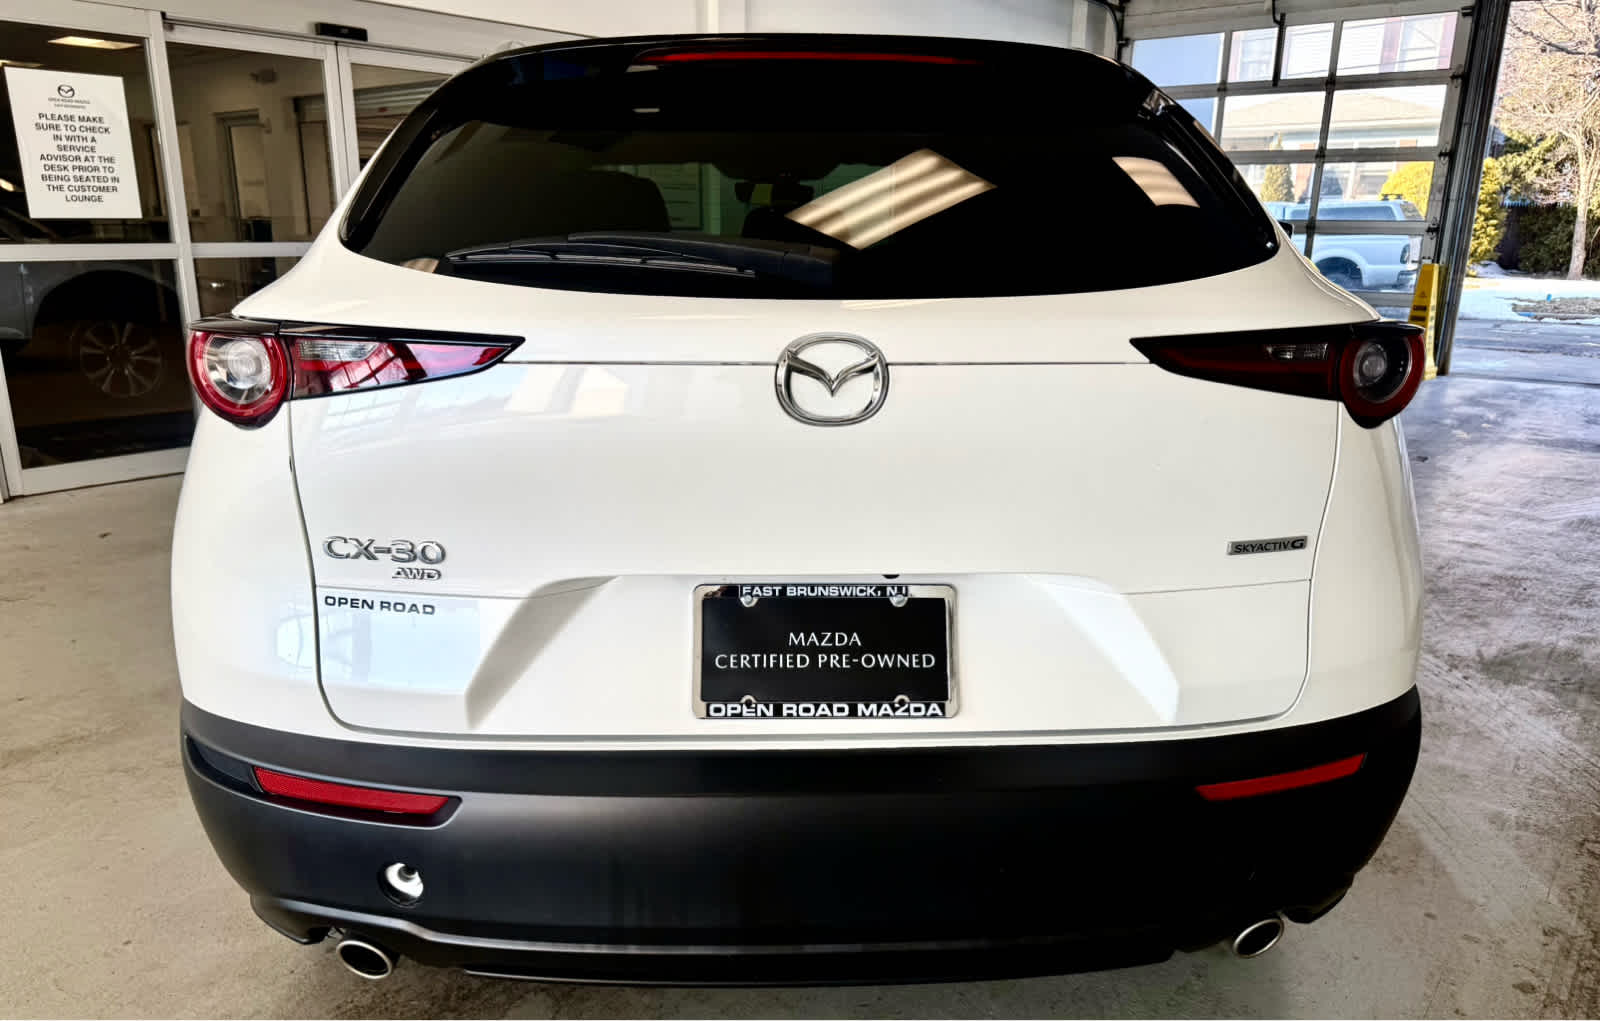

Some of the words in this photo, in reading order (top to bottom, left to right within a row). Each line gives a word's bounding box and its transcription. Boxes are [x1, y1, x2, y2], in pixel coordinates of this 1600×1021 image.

[38, 112, 75, 122] PLEASE
[78, 115, 104, 124] MAKE
[35, 122, 61, 131] SURE
[64, 124, 77, 133] TO
[79, 125, 111, 134] CHECK
[53, 134, 63, 142] IN
[64, 135, 88, 143] WITH
[56, 144, 97, 153] SERVICE
[40, 153, 82, 162] ADVISOR
[98, 156, 116, 164] THE
[43, 164, 70, 172] DESK
[72, 165, 100, 173] PRIOR
[103, 166, 115, 174] TO
[41, 174, 71, 183] BEING
[73, 175, 109, 183] SEATED
[111, 176, 120, 184] IN
[46, 184, 65, 192] THE
[67, 184, 118, 193] CUSTOMER
[65, 194, 104, 203] LOUNGE
[323, 535, 447, 565] CX-30
[391, 567, 442, 580] AWD
[786, 586, 882, 598] BRUNSWICK,
[324, 595, 375, 610] OPEN
[380, 600, 436, 615] ROAD
[788, 632, 862, 647] MAZDA
[714, 653, 810, 669] CERTIFIED
[818, 653, 936, 669] PRE-OWNED
[709, 703, 774, 717] OPEN
[782, 703, 850, 717] ROAD
[857, 703, 944, 717] MAZDA
